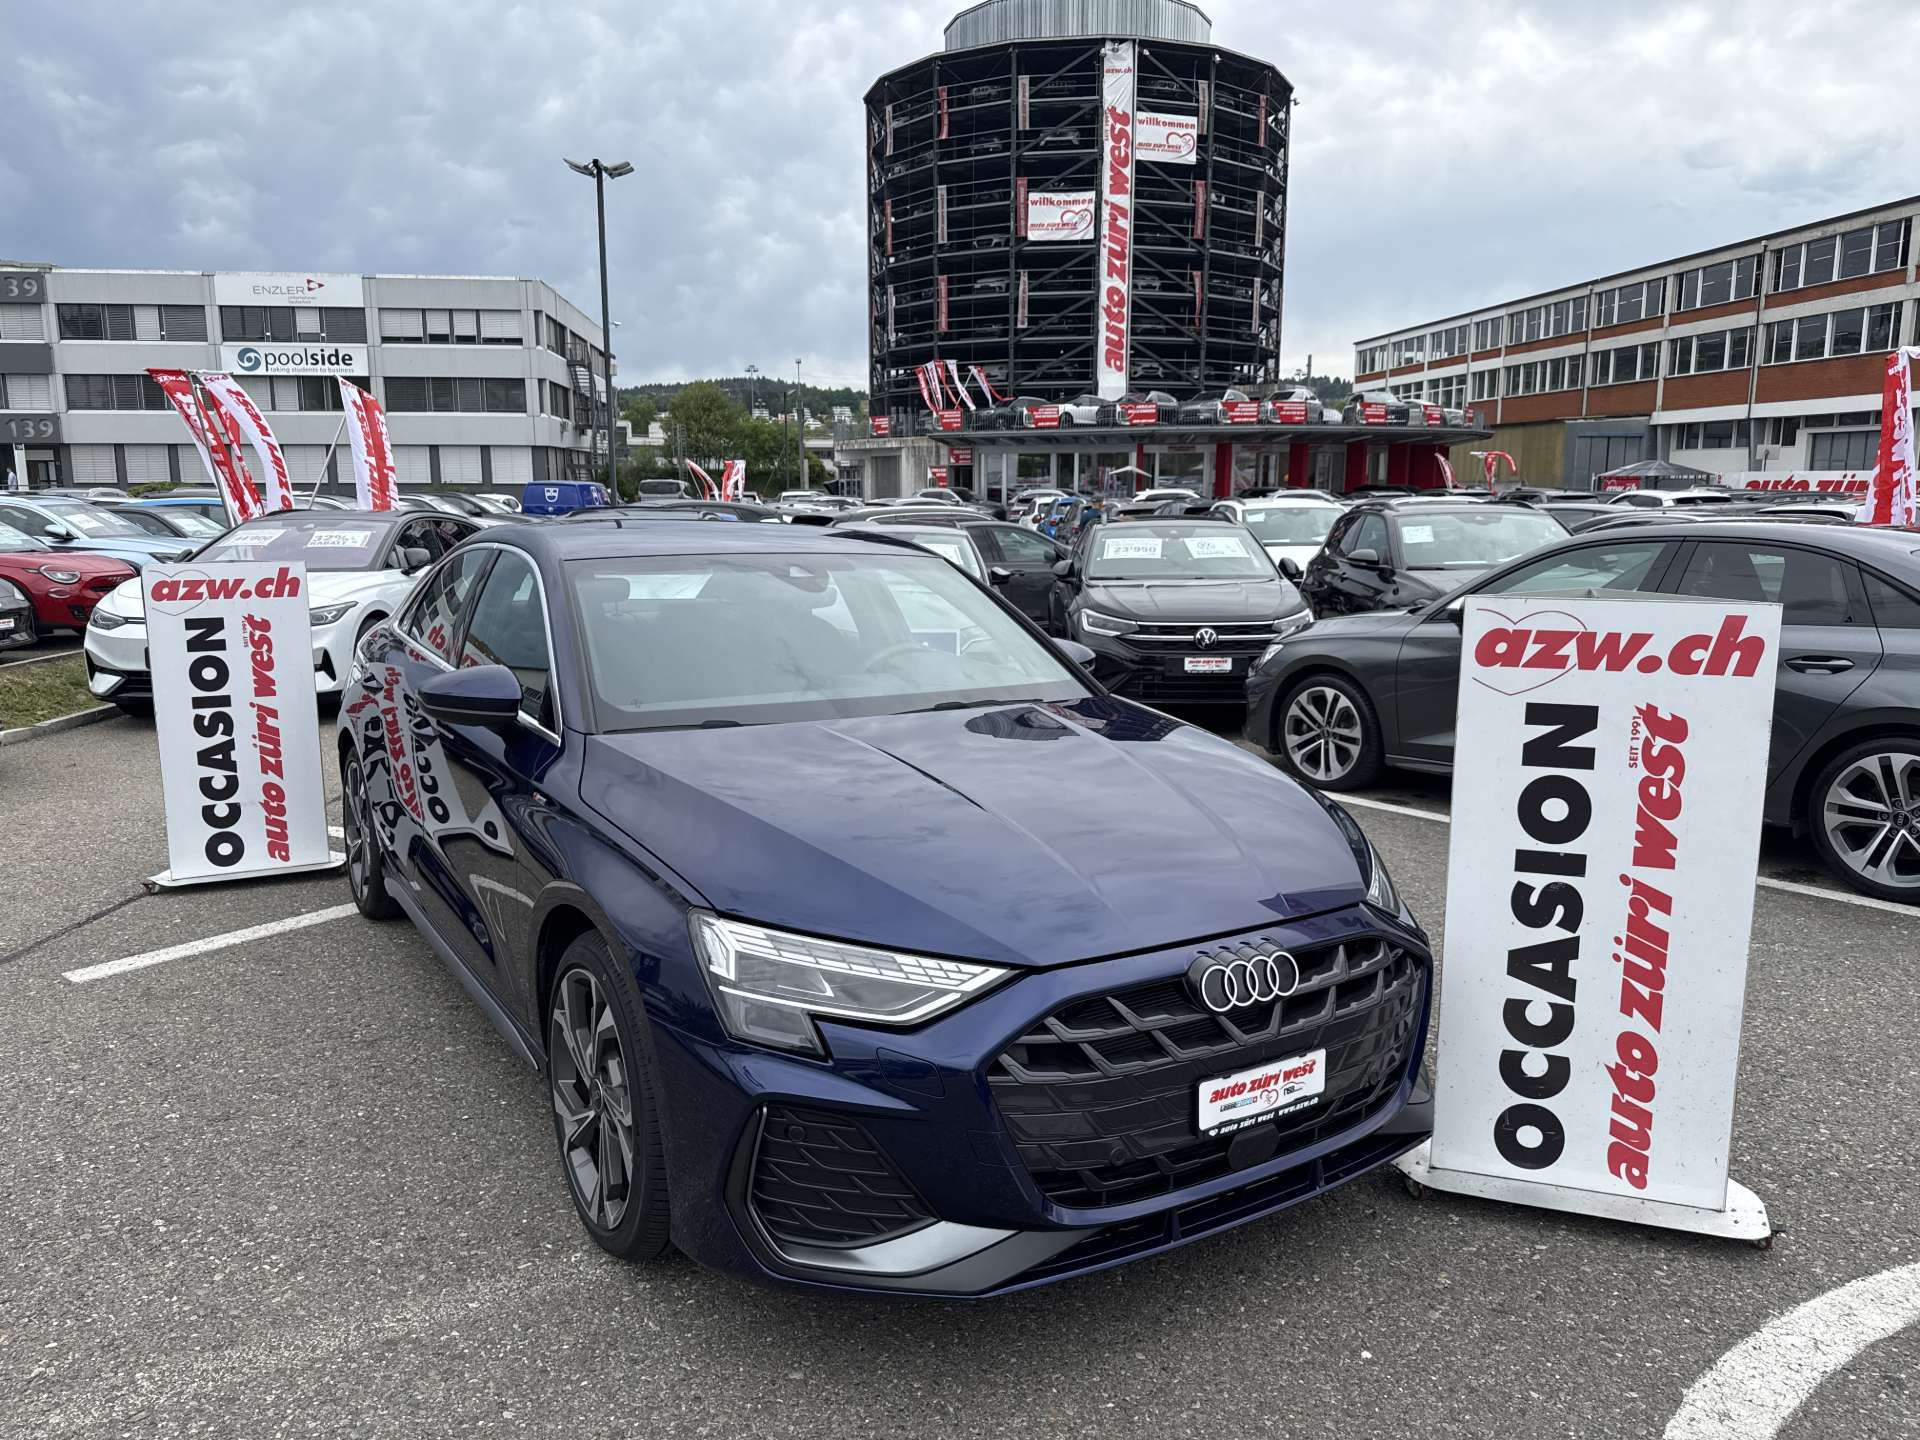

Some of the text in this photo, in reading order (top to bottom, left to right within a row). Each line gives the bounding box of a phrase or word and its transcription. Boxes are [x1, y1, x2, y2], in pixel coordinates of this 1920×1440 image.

[1137, 117, 1196, 130] willkommen
[1030, 197, 1094, 207] willkommen
[1102, 105, 1131, 372] auto züri west
[252, 285, 305, 295] ENZLER
[264, 347, 353, 372] poolside
[6, 418, 54, 438] 139
[150, 567, 301, 602] azw.ch
[1474, 615, 1766, 678] azw.ch
[184, 617, 245, 867] OCCASION
[241, 613, 291, 863] auto züri west
[1628, 715, 1642, 769] SEIT 1991
[1493, 702, 1599, 1170] OCCASION
[1603, 702, 1688, 1191] auto züri west
[1209, 1081, 1247, 1104] auto
[1247, 1070, 1282, 1093] züri
[1283, 1059, 1316, 1083] west
[1219, 1097, 1319, 1134] auto züri west www.azw.ch
